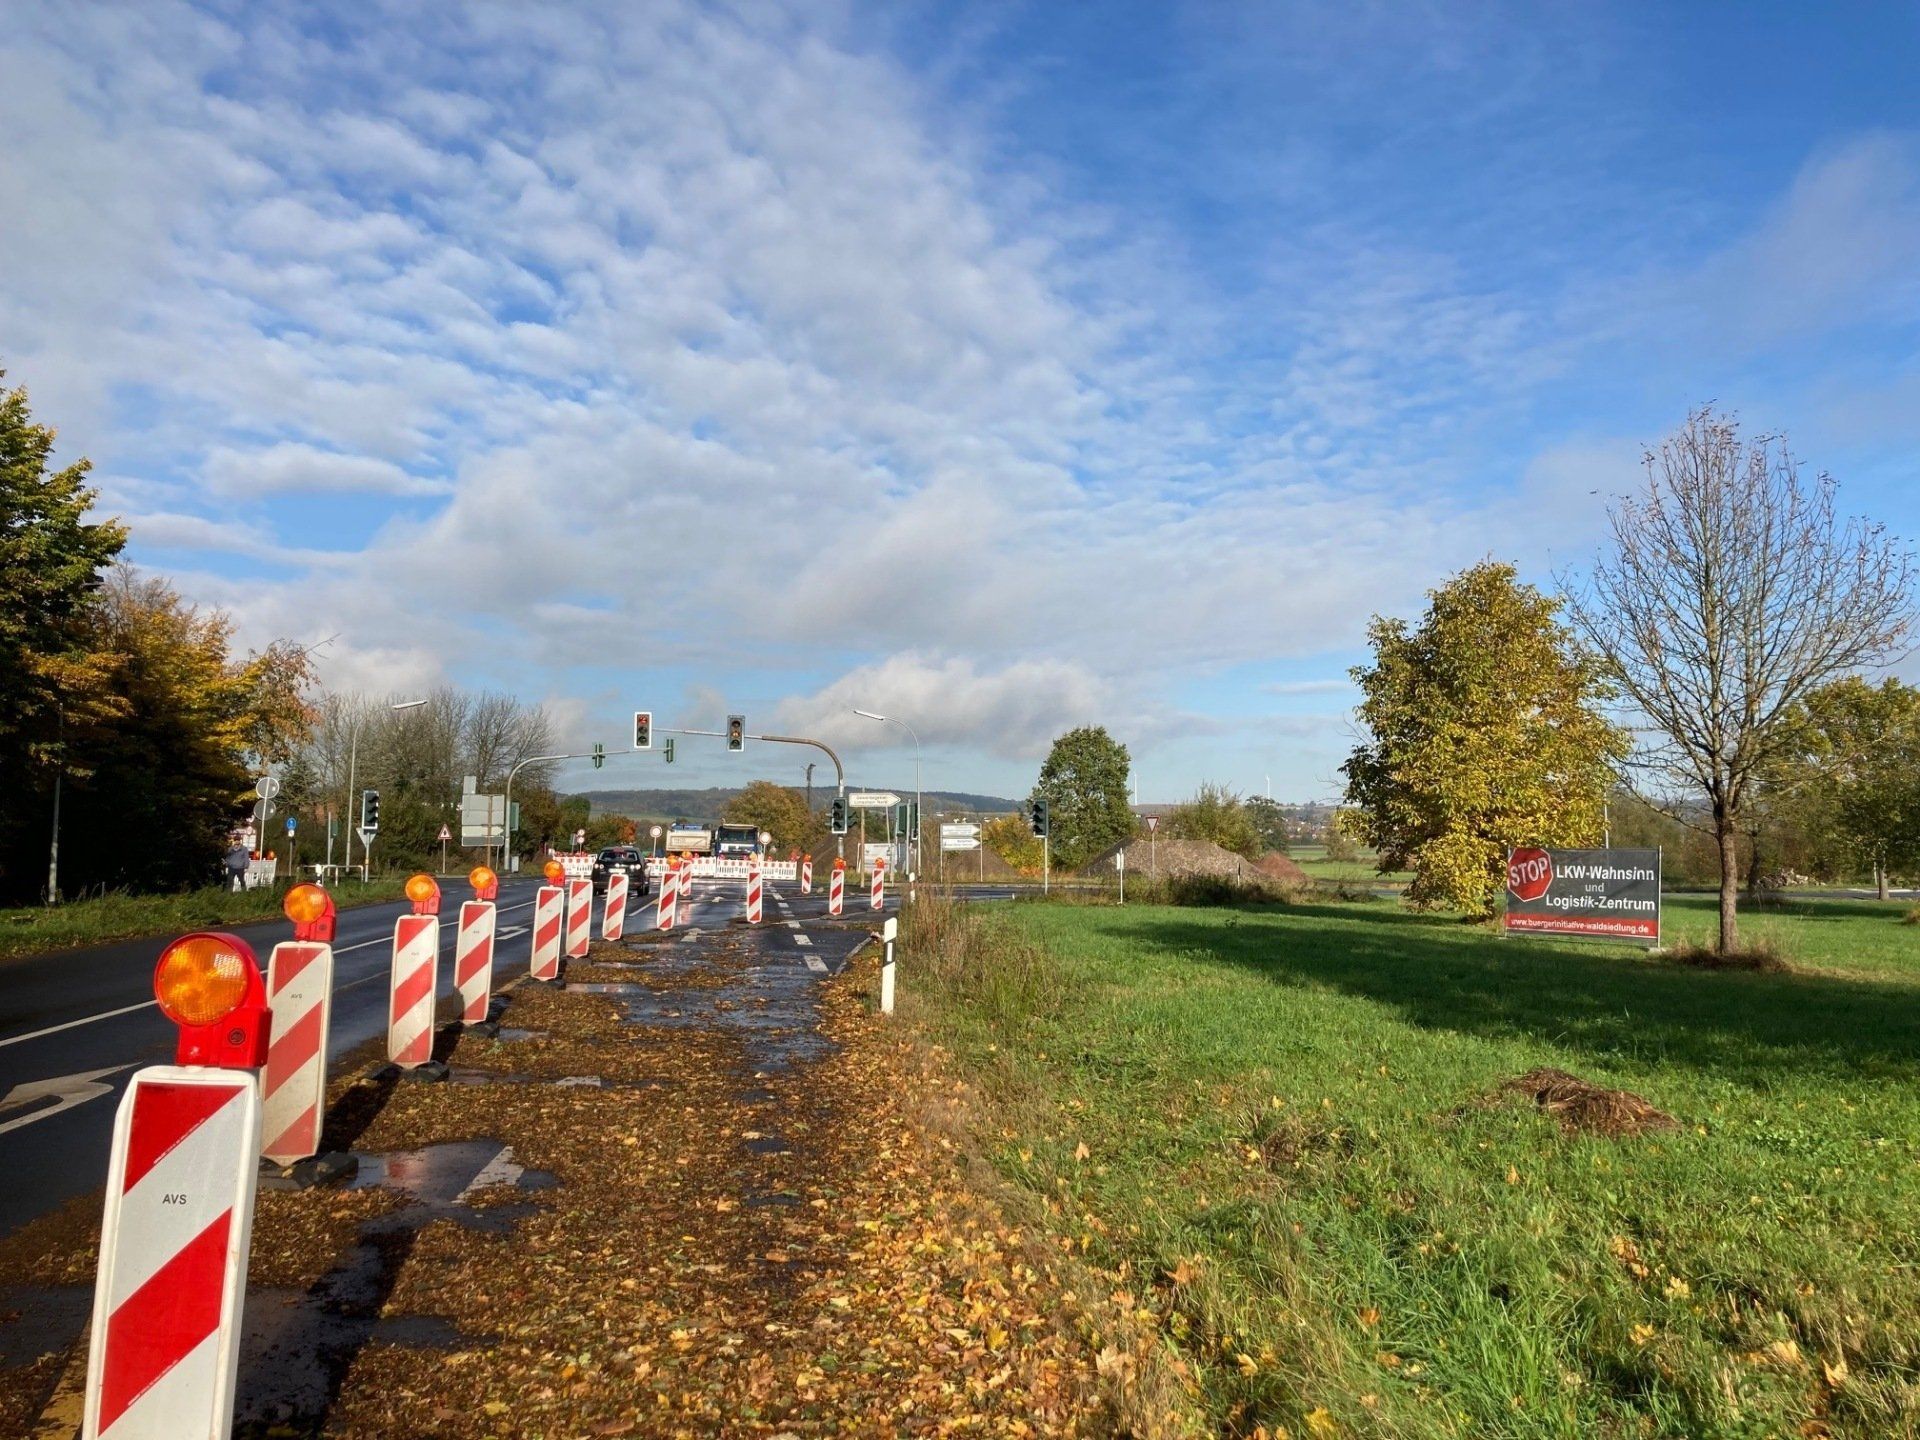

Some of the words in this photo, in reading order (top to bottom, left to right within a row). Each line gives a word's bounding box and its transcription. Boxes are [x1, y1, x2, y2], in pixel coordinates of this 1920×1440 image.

[1509, 857, 1548, 887] STOP
[1556, 865, 1655, 881] LKW-Wahnsinn
[1585, 883, 1605, 893] und
[1546, 894, 1656, 911] Logistik-Zentrum
[1511, 918, 1649, 933] www.buergerinitiative-waldsiedlung.de
[162, 1193, 187, 1205] AVS
